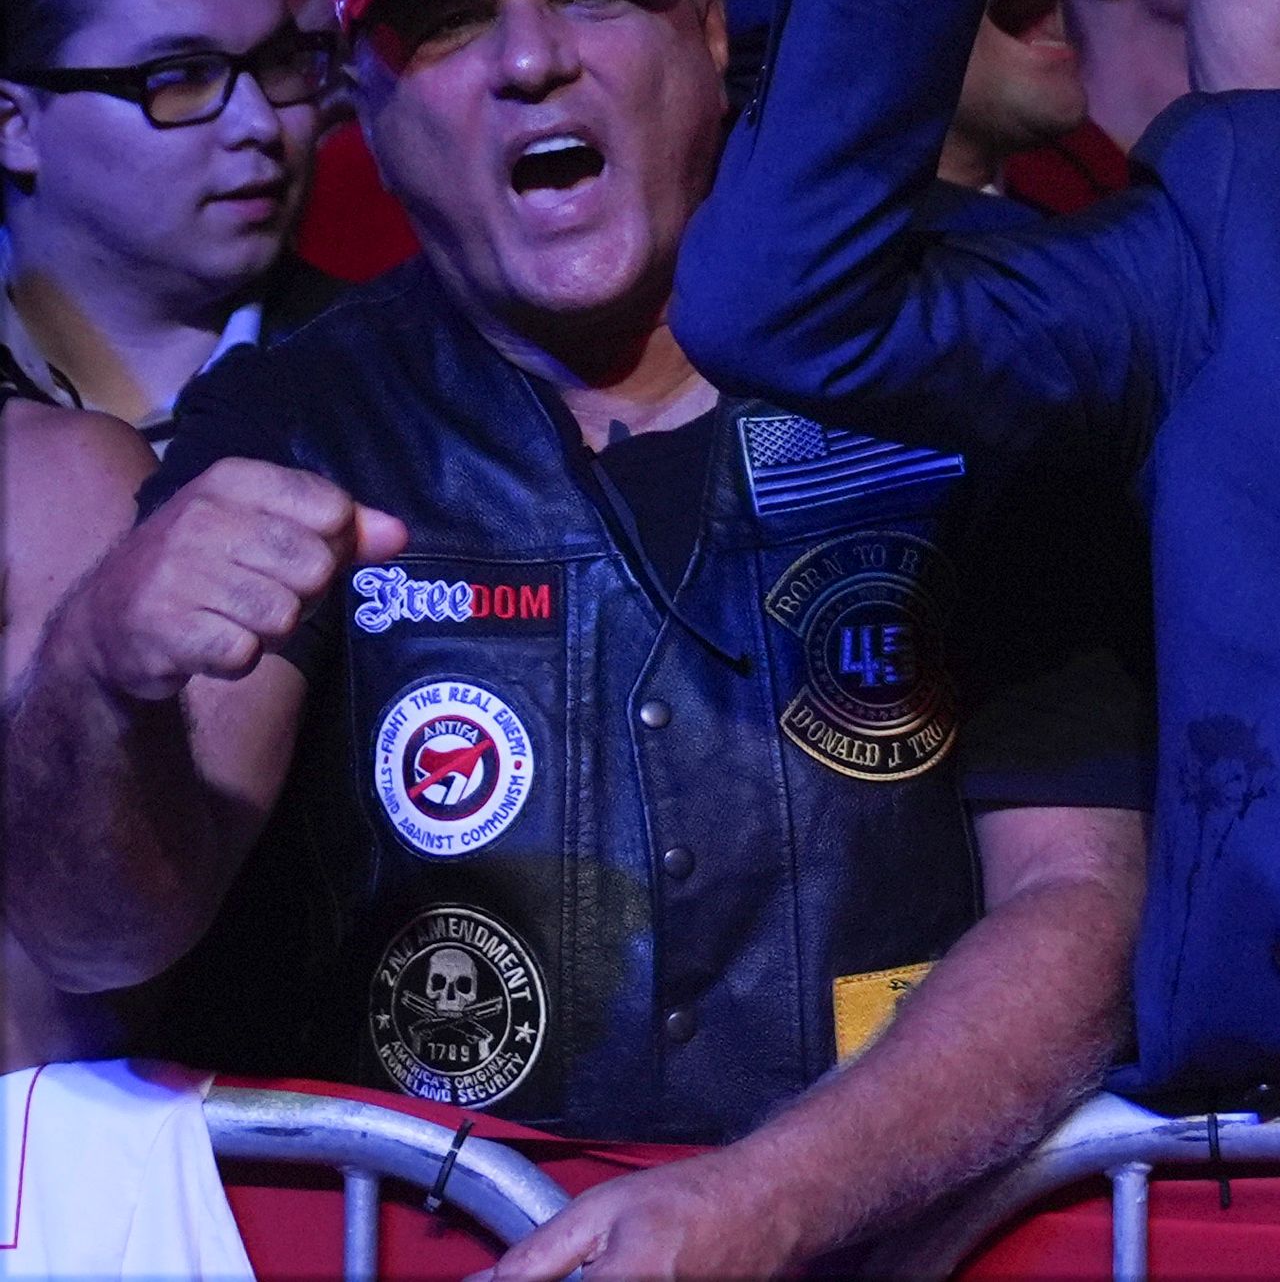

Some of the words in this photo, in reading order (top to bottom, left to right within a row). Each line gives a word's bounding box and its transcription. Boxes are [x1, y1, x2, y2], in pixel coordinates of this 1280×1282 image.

[352, 566, 551, 635] FreeDOM
[775, 552, 849, 616] BORN
[852, 543, 887, 568] TO
[381, 706, 408, 755] FIGHT
[409, 687, 443, 710] THE
[448, 686, 494, 713] REAL
[492, 708, 527, 757] ENEMY
[423, 720, 480, 743] ANTIFA
[790, 704, 881, 767] DONALD
[887, 742, 903, 768] J
[381, 766, 400, 815] STAND
[397, 816, 455, 850] AGAINST
[460, 774, 526, 847] COMMUNISM
[418, 916, 533, 1002] AMENDMENT
[379, 1043, 453, 1103] HOMELAND
[456, 1051, 526, 1104] SECURITY
[391, 1040, 452, 1089] AMERICA'S
[453, 1050, 513, 1089] ORIGINAL
